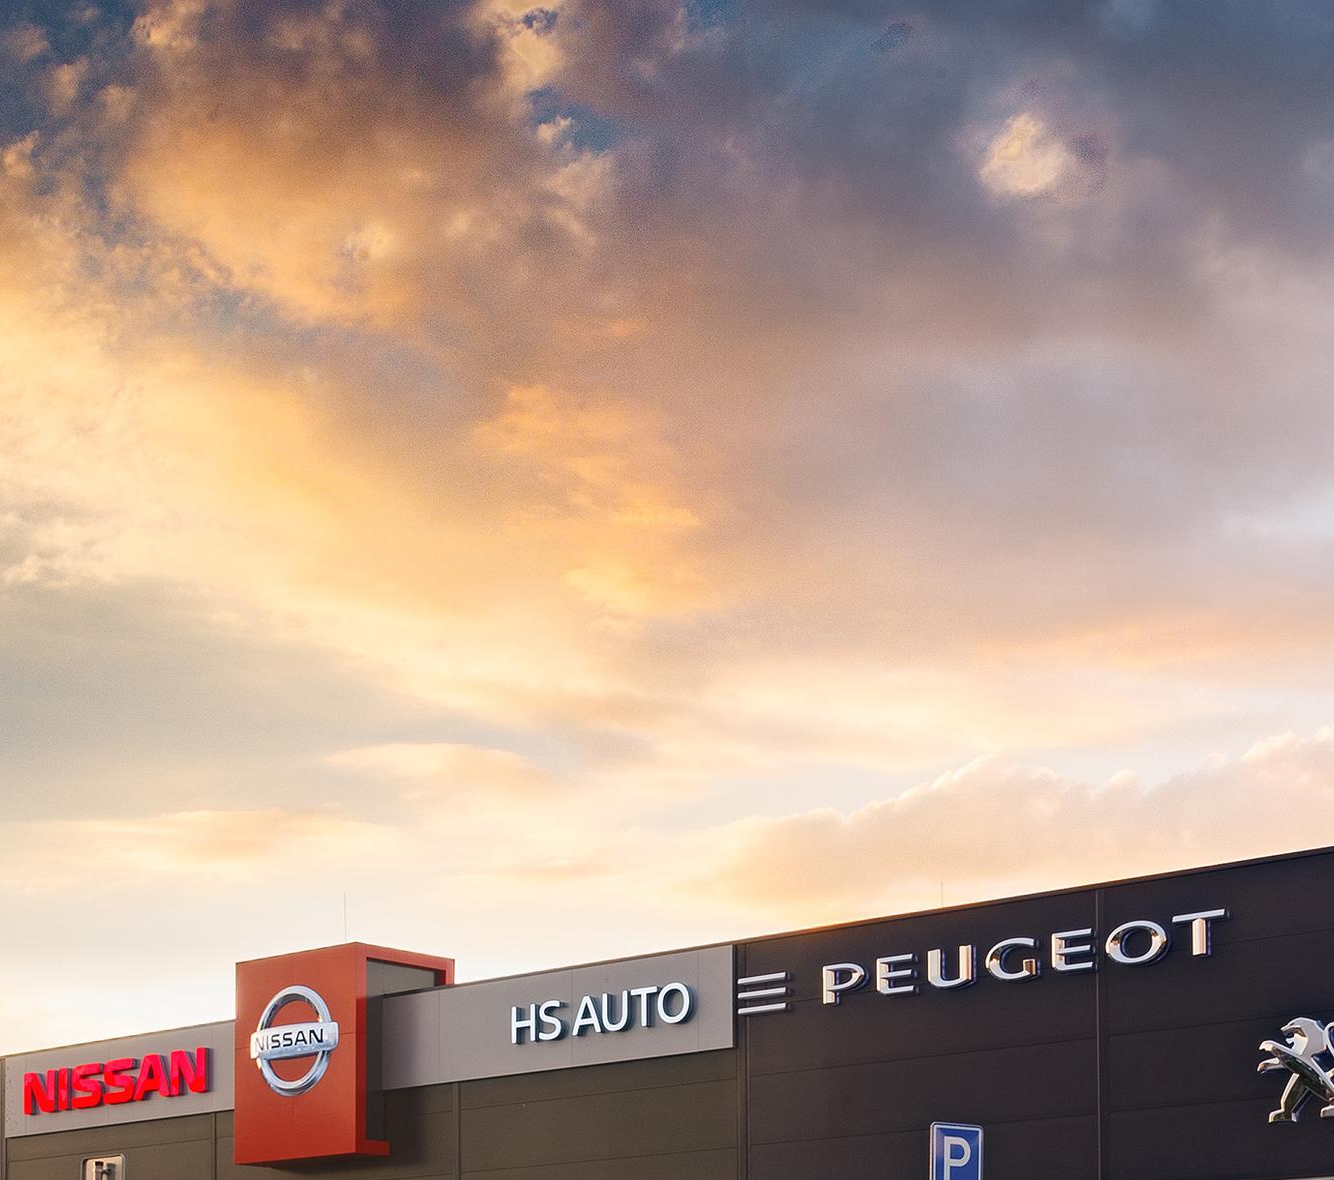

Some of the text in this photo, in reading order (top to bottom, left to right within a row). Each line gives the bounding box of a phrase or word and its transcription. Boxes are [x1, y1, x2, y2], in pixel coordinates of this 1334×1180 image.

[822, 908, 1228, 1005] PEUGEOT
[254, 1027, 326, 1051] NISSAN
[511, 982, 692, 1045] HS AUTO
[23, 1047, 210, 1116] NISSAN
